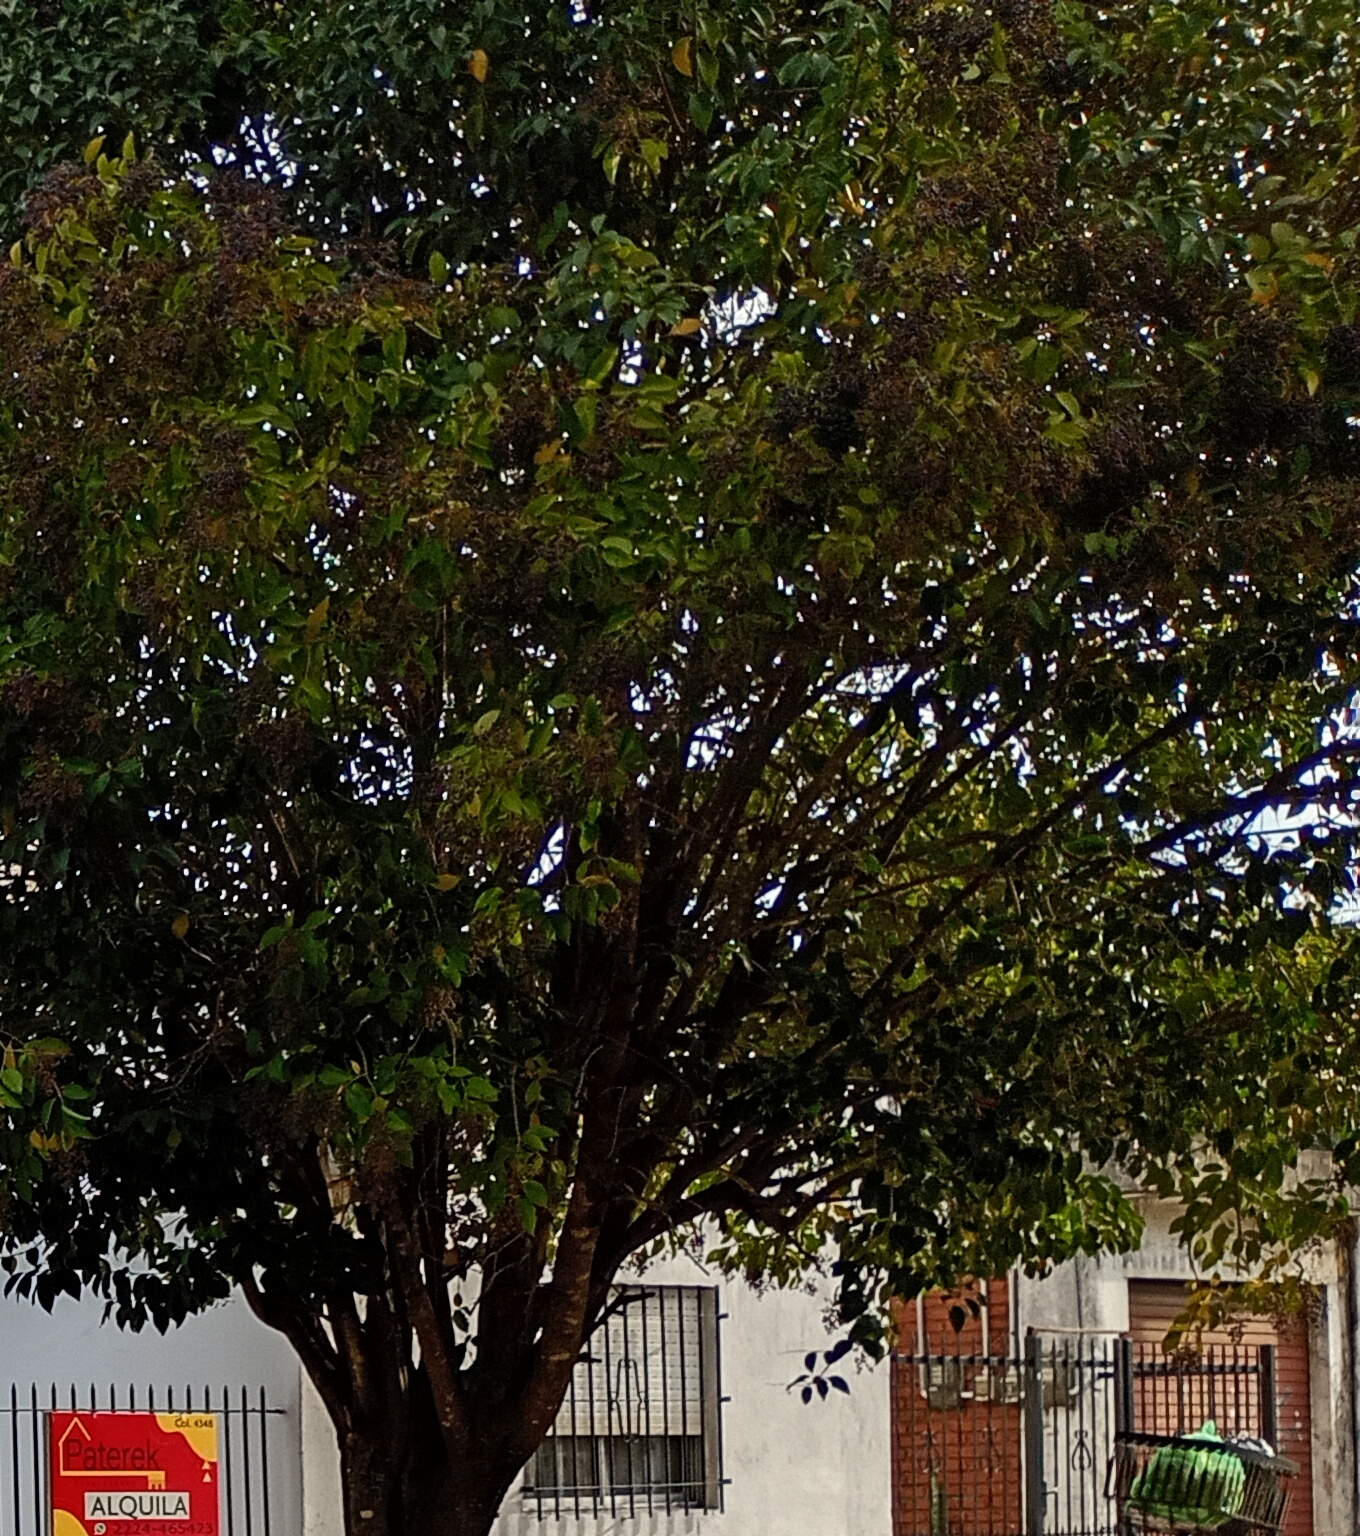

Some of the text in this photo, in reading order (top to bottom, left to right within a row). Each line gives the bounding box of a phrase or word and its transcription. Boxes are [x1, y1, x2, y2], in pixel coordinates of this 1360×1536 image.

[66, 1439, 160, 1470] Paterek
[91, 1495, 187, 1519] ALQUILA
[113, 1523, 214, 1534] 2224-465423
